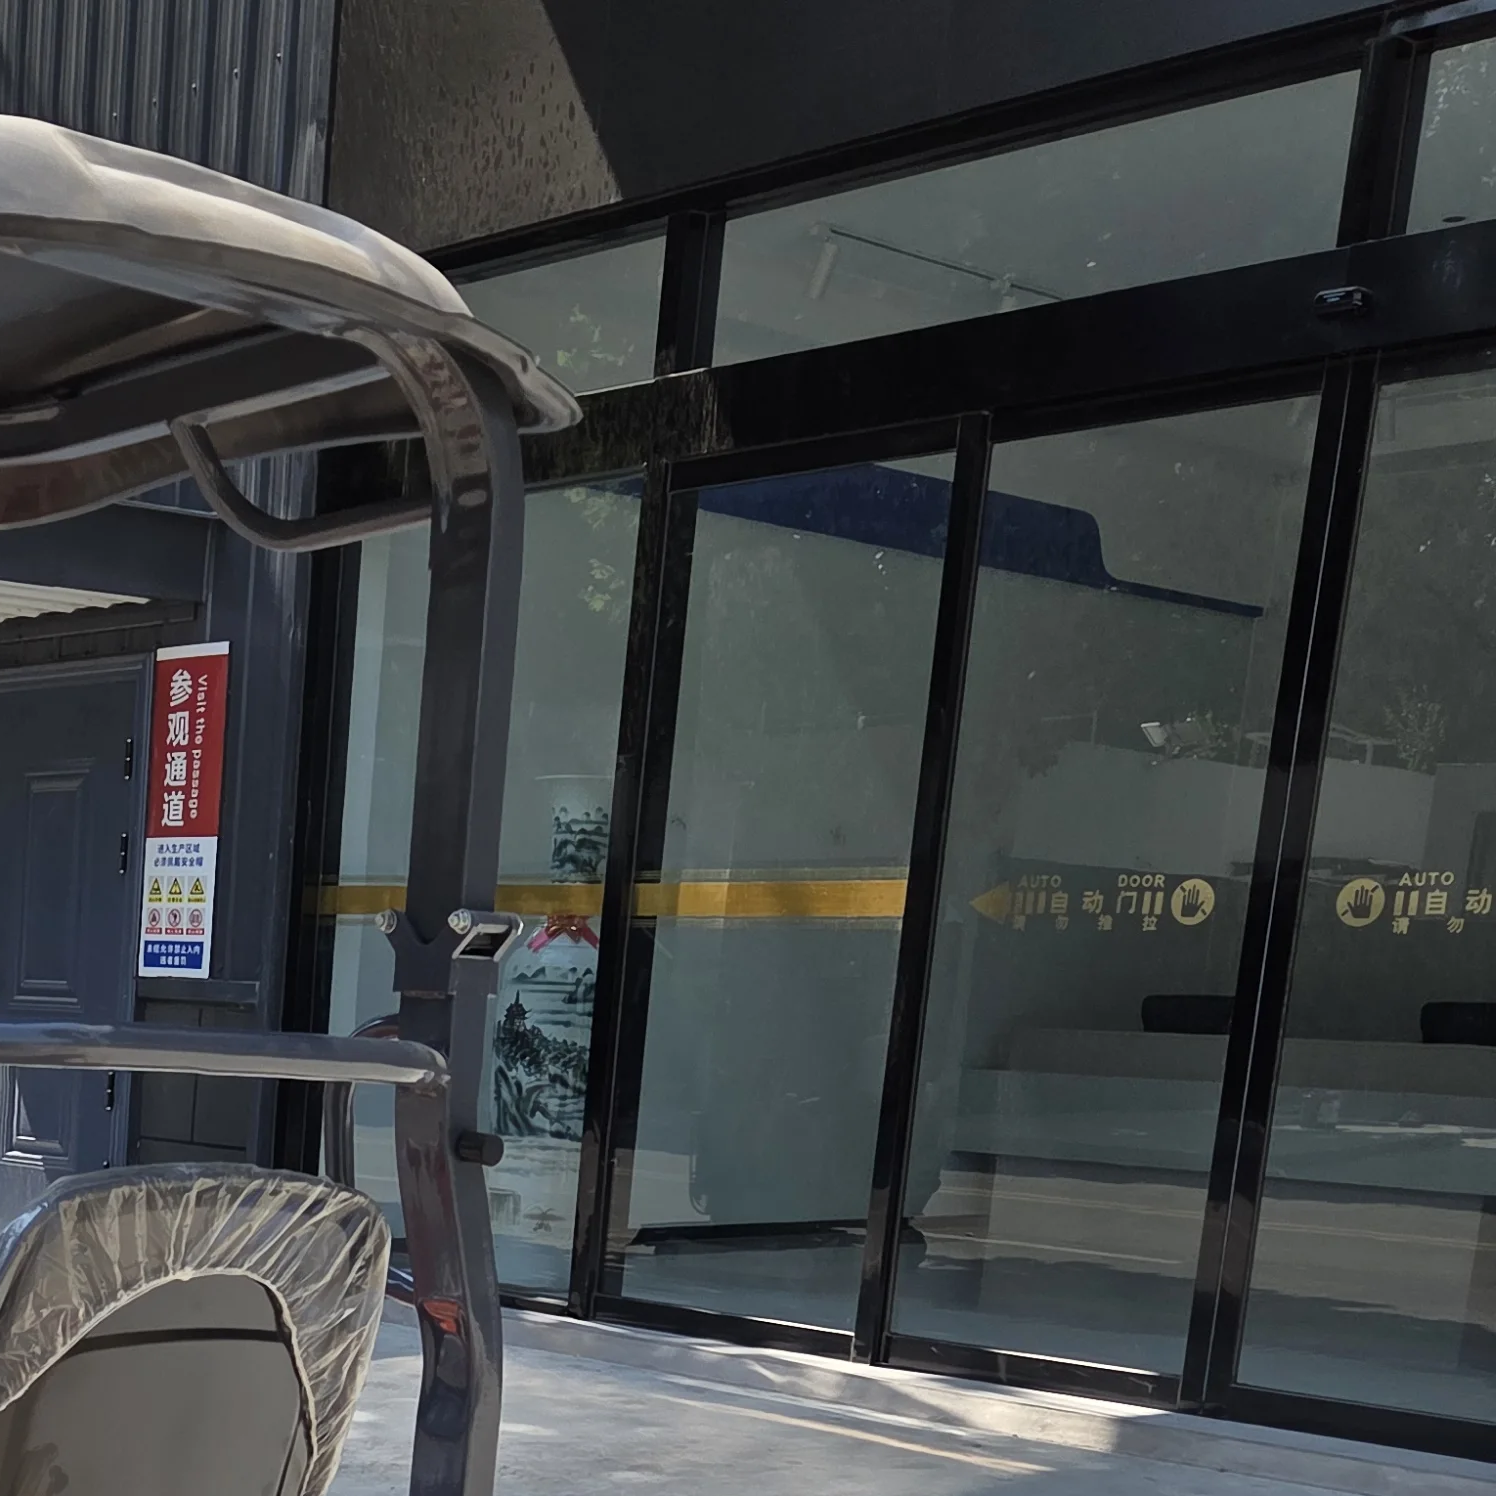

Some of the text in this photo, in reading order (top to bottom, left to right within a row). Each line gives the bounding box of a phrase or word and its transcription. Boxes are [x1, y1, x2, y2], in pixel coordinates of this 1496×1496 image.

[161, 668, 193, 827] 参观通道
[1017, 874, 1165, 888] AUTO DOOR
[1398, 871, 1455, 887] AUTO
